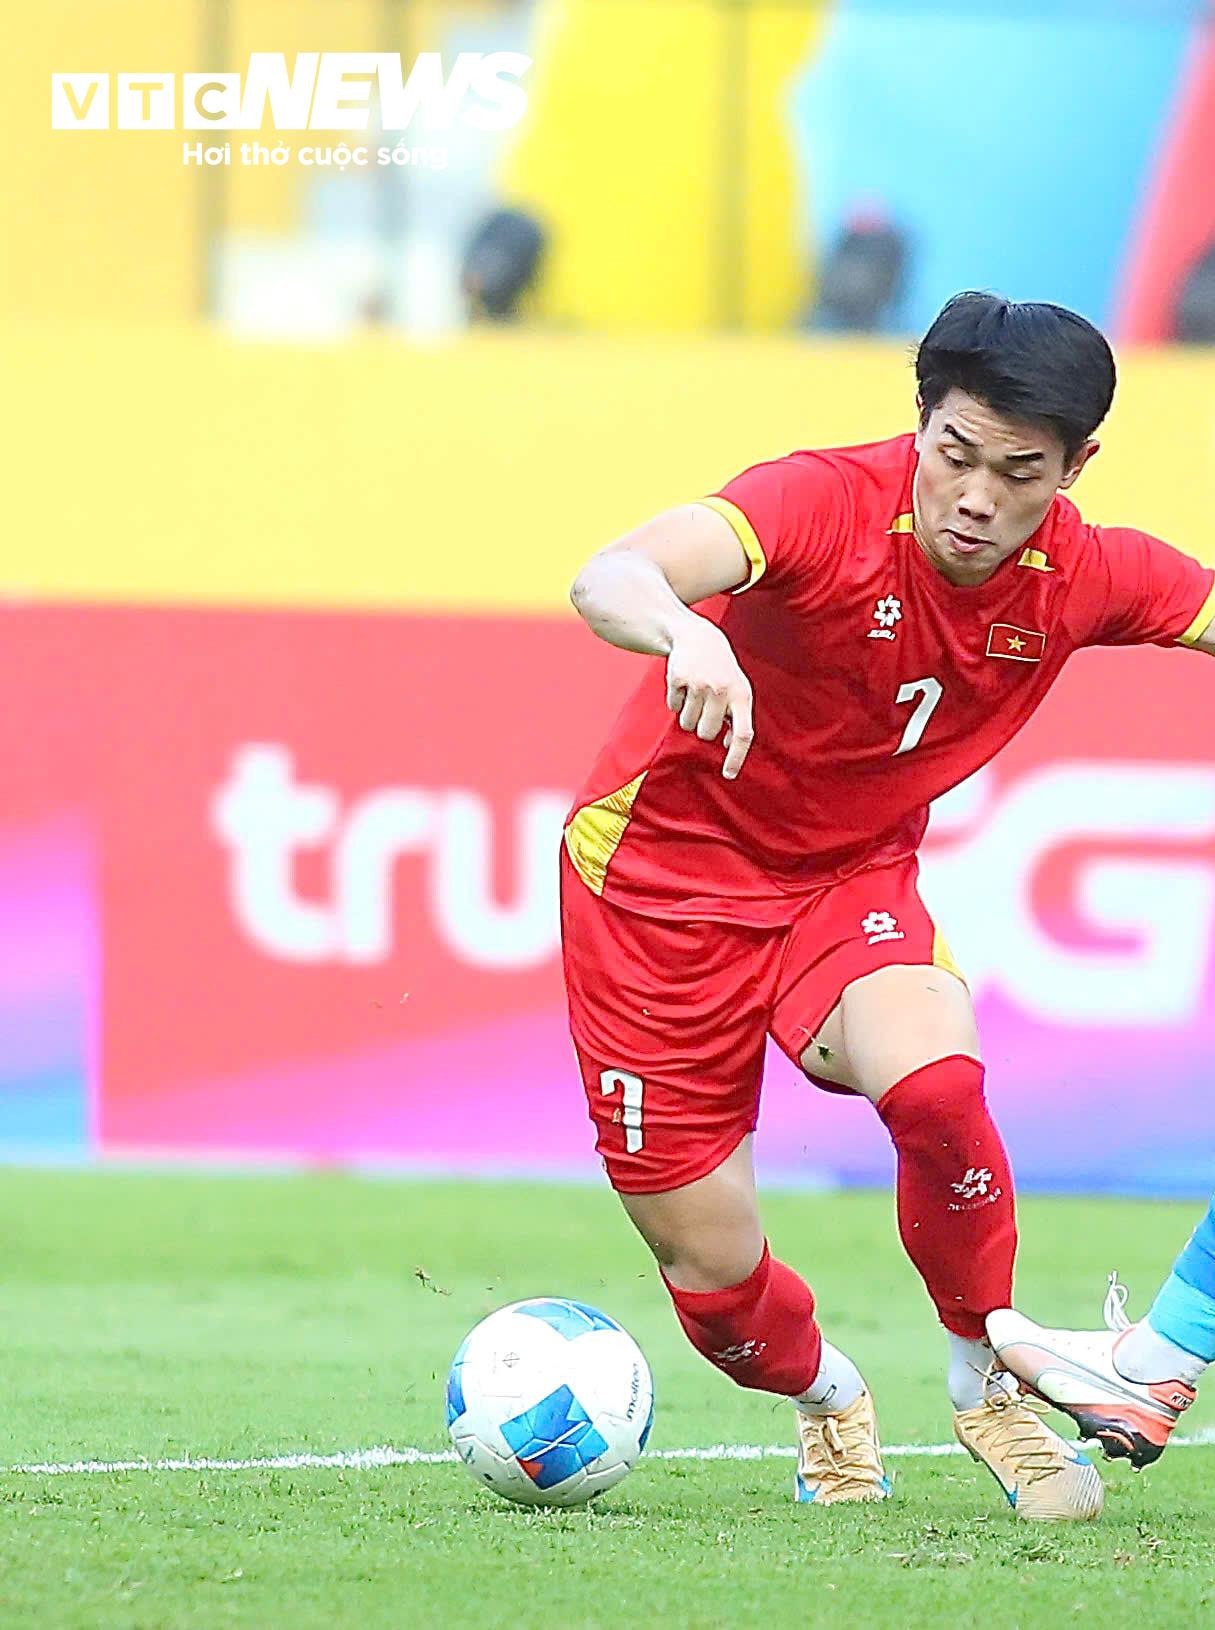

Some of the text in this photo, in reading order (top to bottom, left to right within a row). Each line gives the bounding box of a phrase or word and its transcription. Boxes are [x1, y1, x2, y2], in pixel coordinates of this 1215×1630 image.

[891, 676, 944, 756] 7
[212, 742, 565, 968] tru
[600, 1068, 644, 1154] 7
